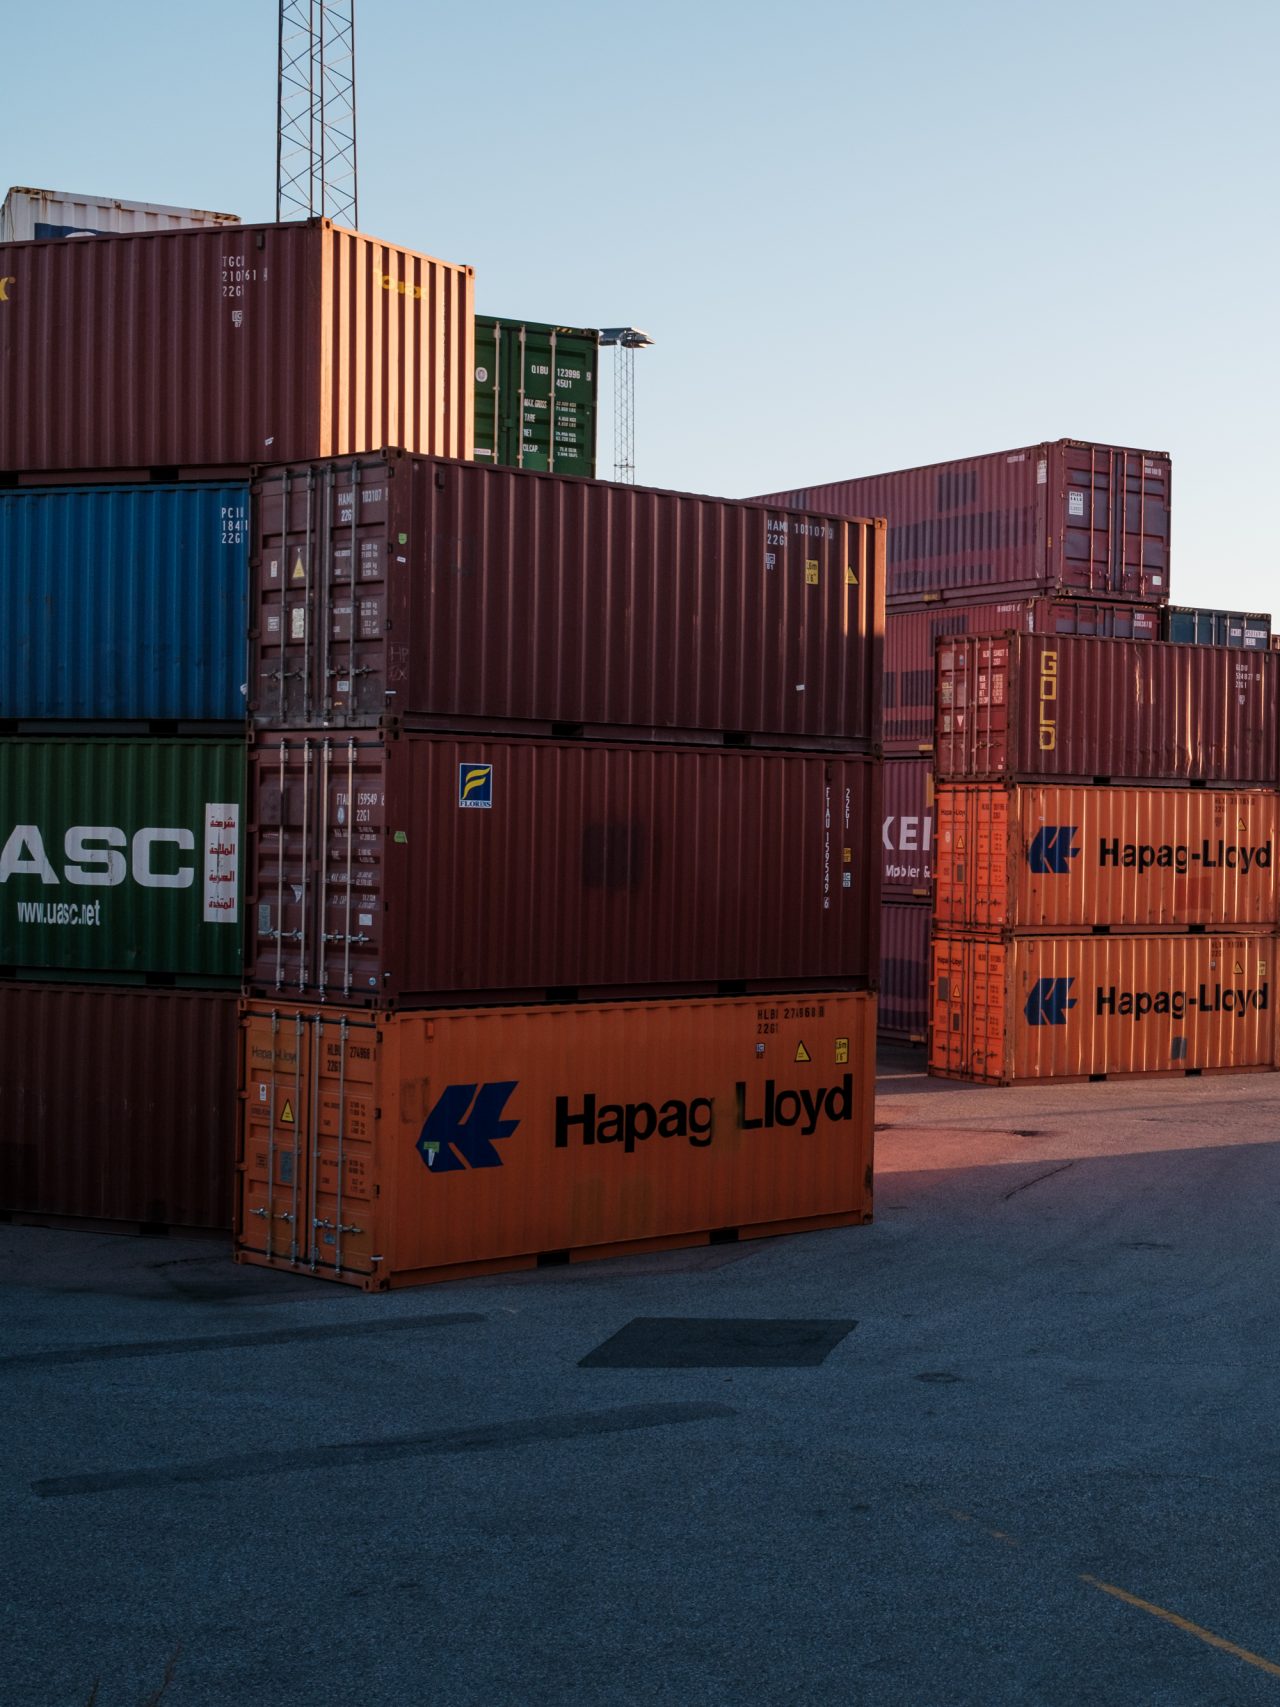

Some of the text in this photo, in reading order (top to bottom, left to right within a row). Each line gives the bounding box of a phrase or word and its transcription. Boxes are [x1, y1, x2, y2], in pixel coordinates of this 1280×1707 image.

[341, 509, 353, 522] 22G
[1039, 650, 1057, 751] GOLD
[1099, 838, 1272, 875] Hapag-Lloyd
[17, 899, 101, 926] www.uasc.net
[1096, 983, 1268, 1020] Hapag-Lloyd
